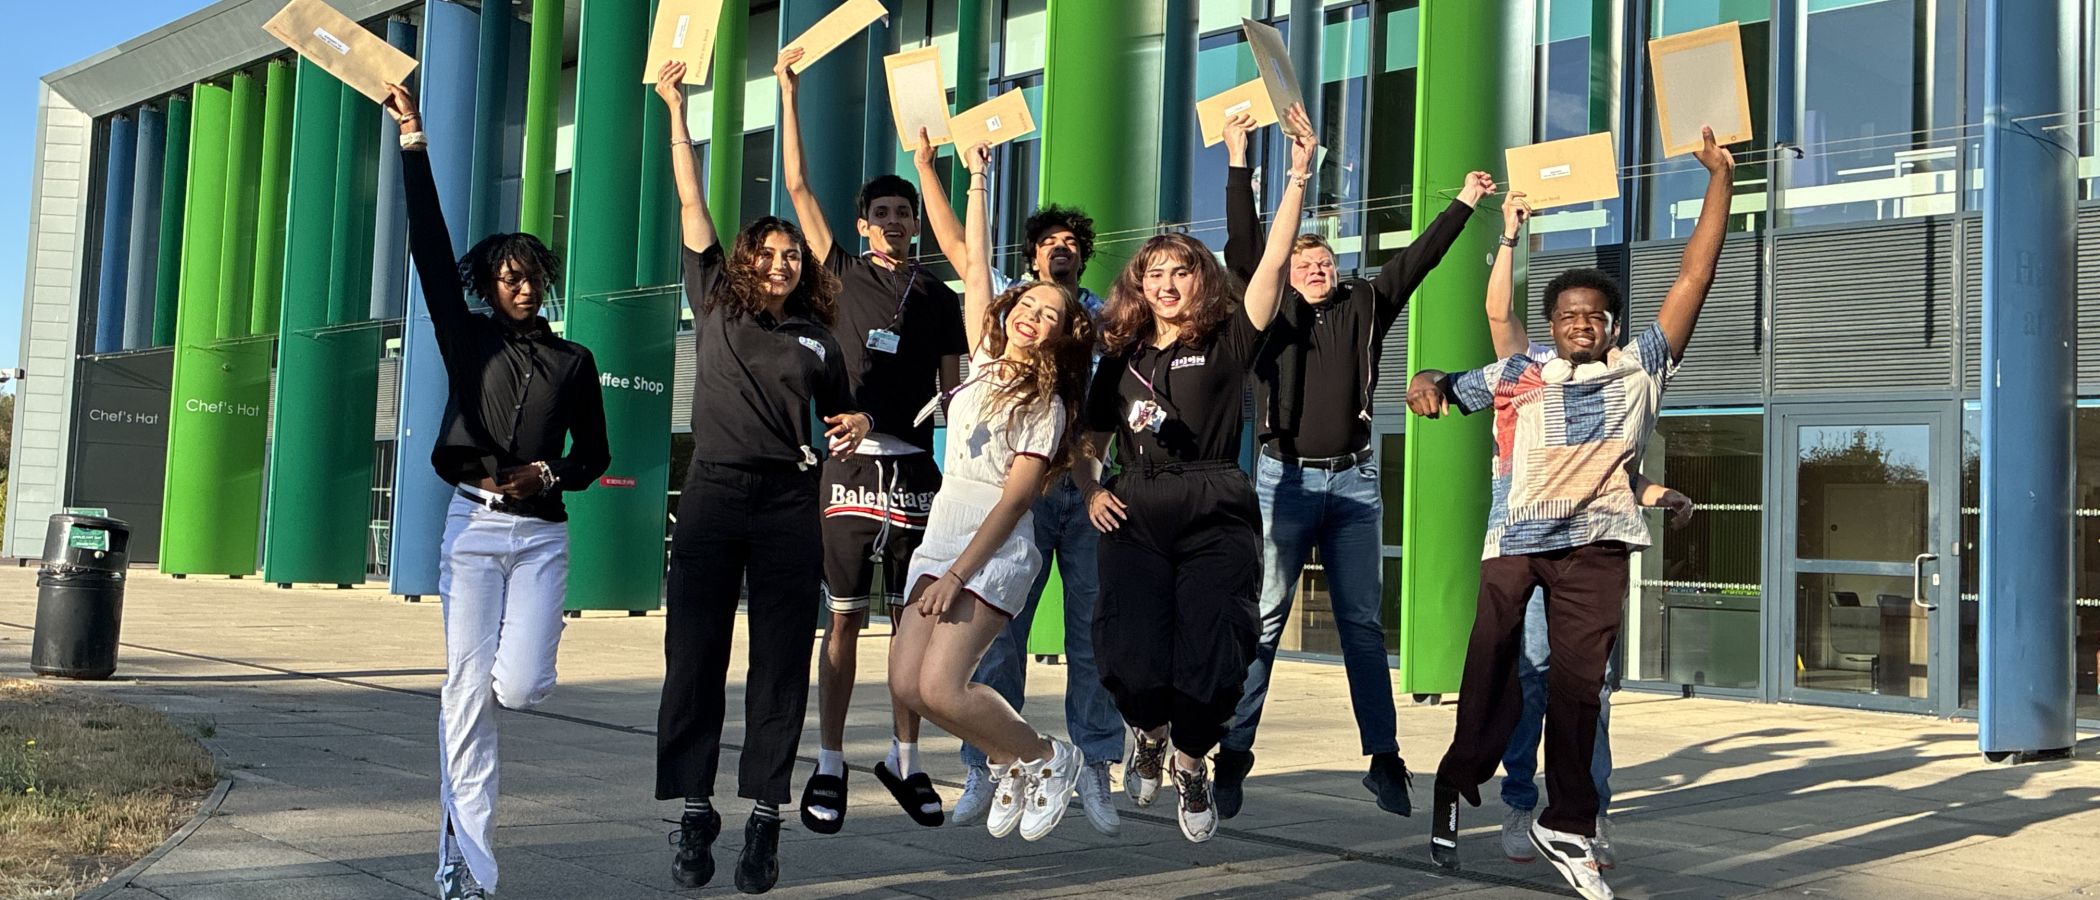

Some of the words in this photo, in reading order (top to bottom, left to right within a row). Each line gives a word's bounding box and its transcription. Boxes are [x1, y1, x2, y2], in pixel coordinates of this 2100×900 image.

[633, 376, 664, 395] Shop
[89, 409, 132, 423] Chef's
[135, 413, 159, 425] Hat
[185, 399, 233, 414] Chef's
[237, 403, 260, 417] Hat
